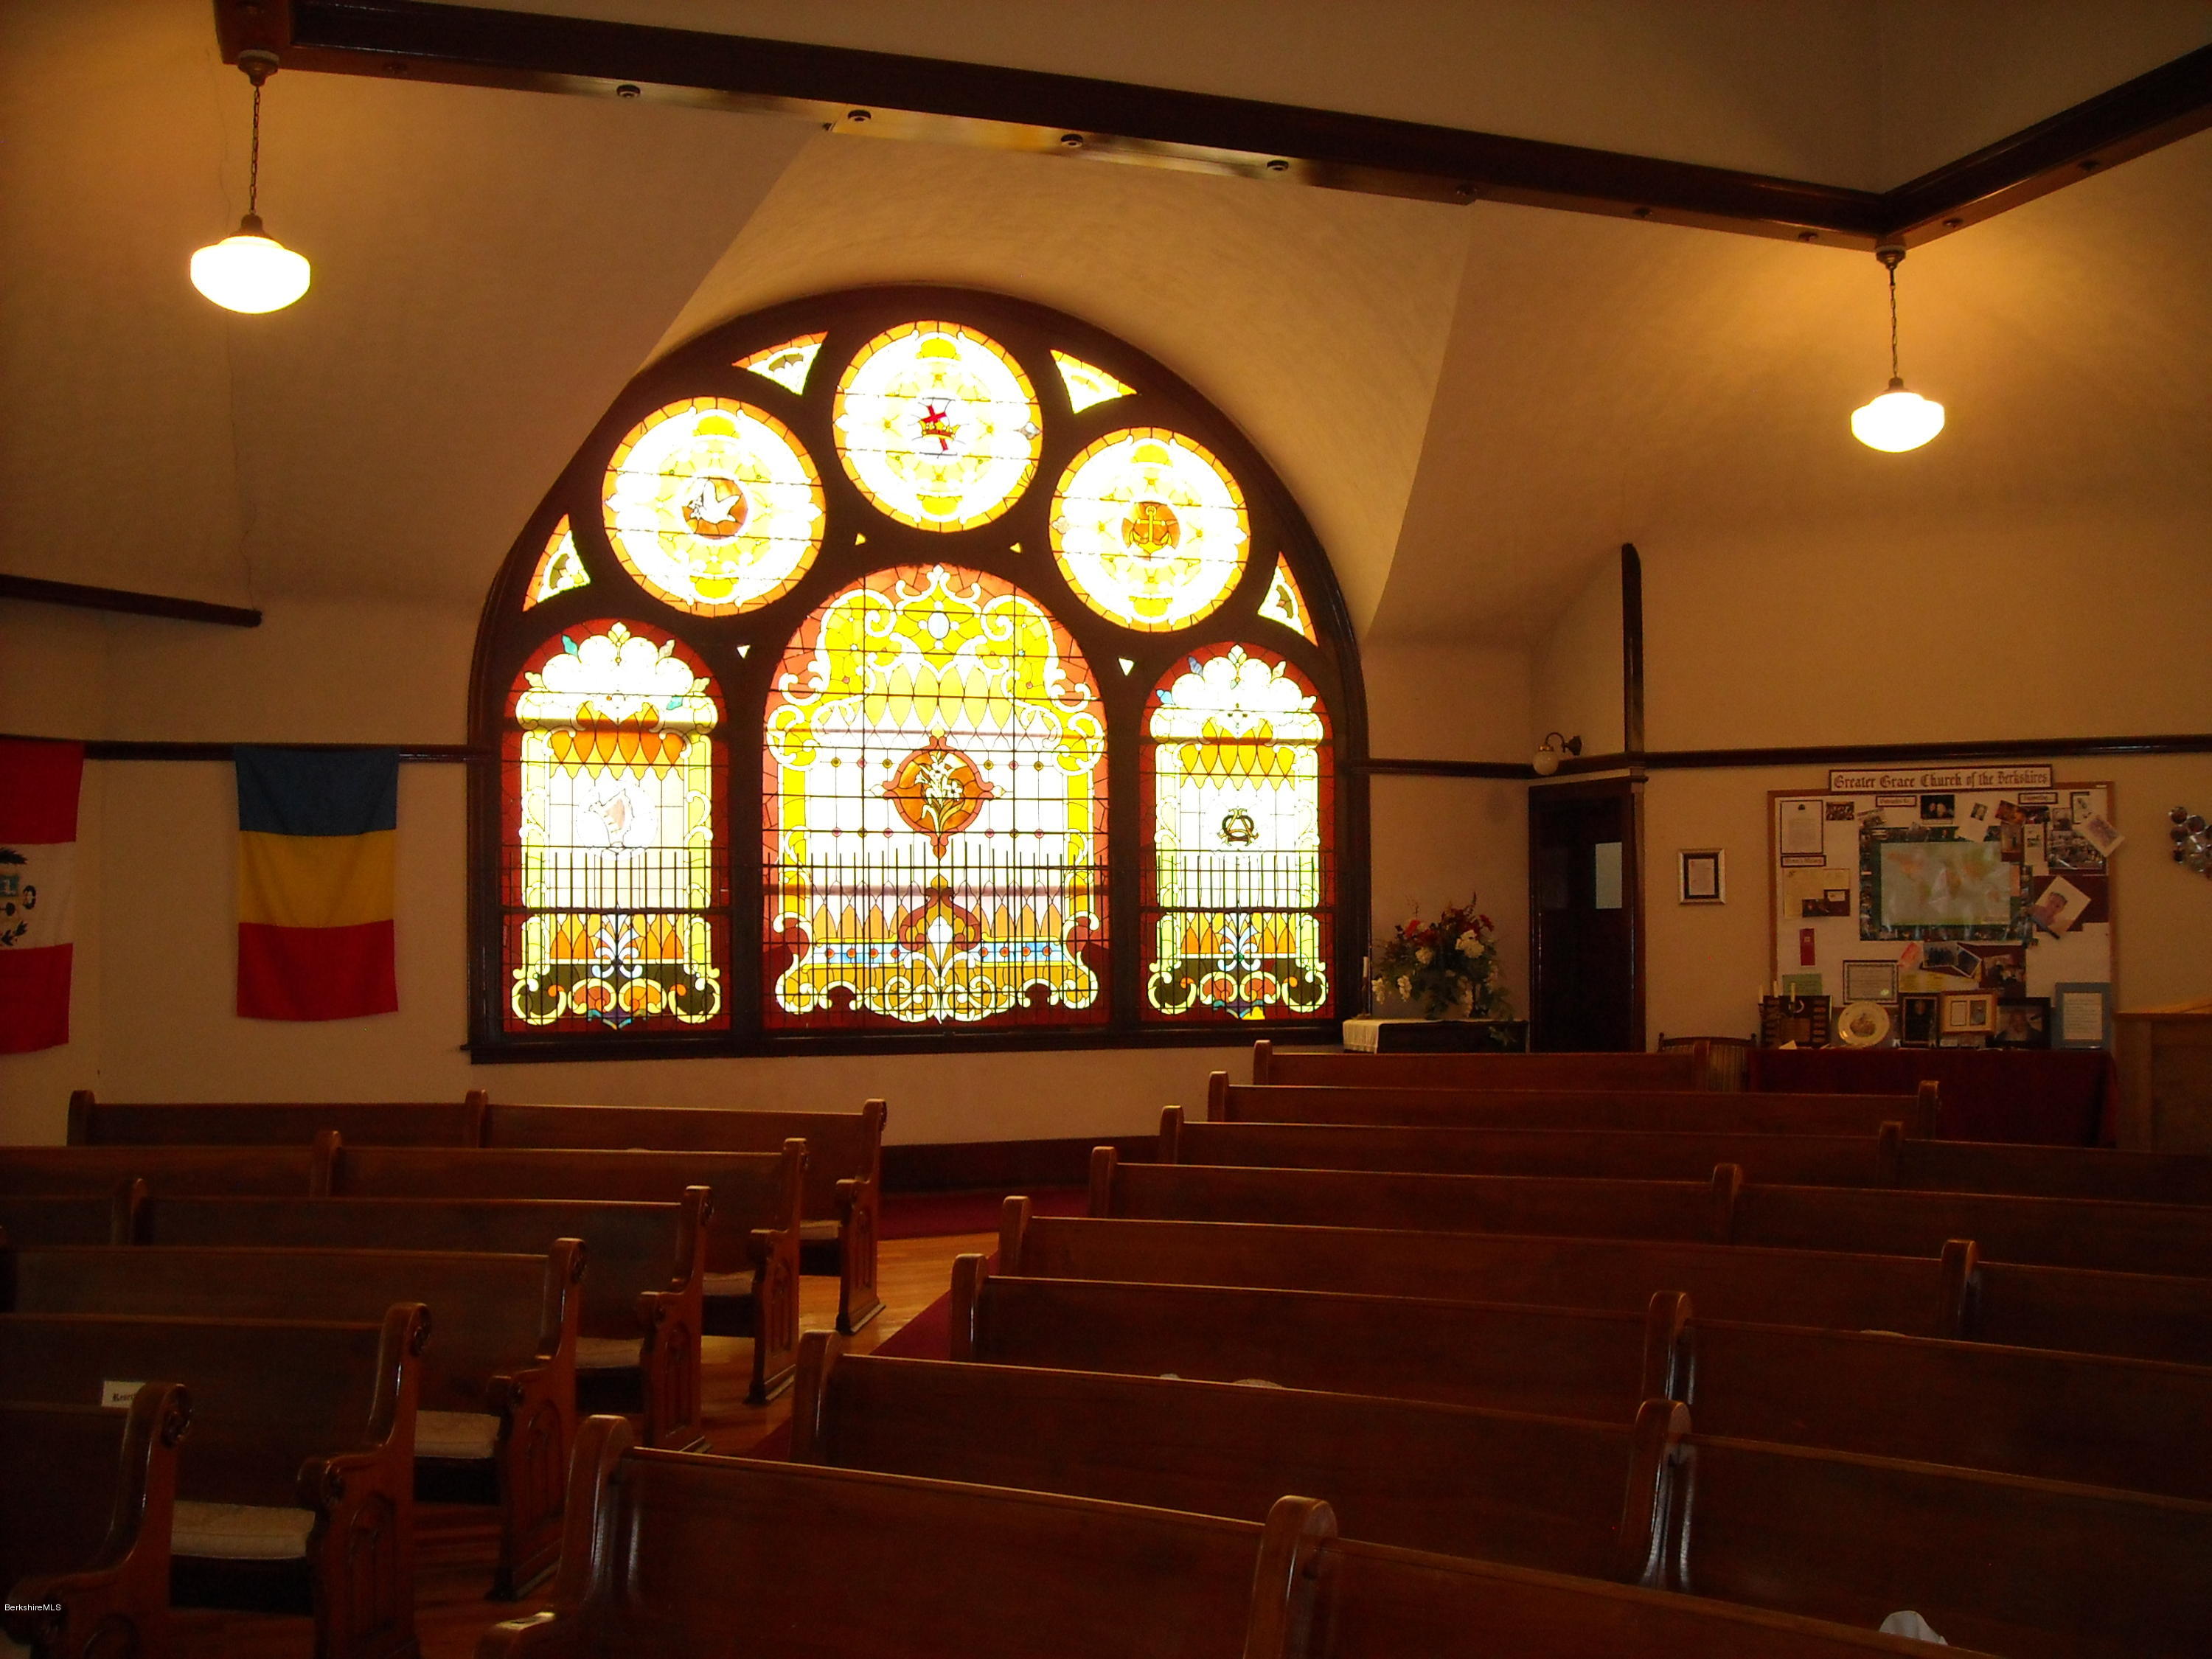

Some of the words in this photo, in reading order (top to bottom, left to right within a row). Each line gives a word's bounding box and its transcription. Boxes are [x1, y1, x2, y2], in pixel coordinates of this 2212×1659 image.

[1834, 775, 1876, 788] Greater
[1880, 774, 1915, 788] Grace
[1921, 772, 1962, 787] Church
[1966, 771, 1978, 787] of
[1978, 771, 1994, 785] the
[1998, 770, 2048, 785] Berkshires
